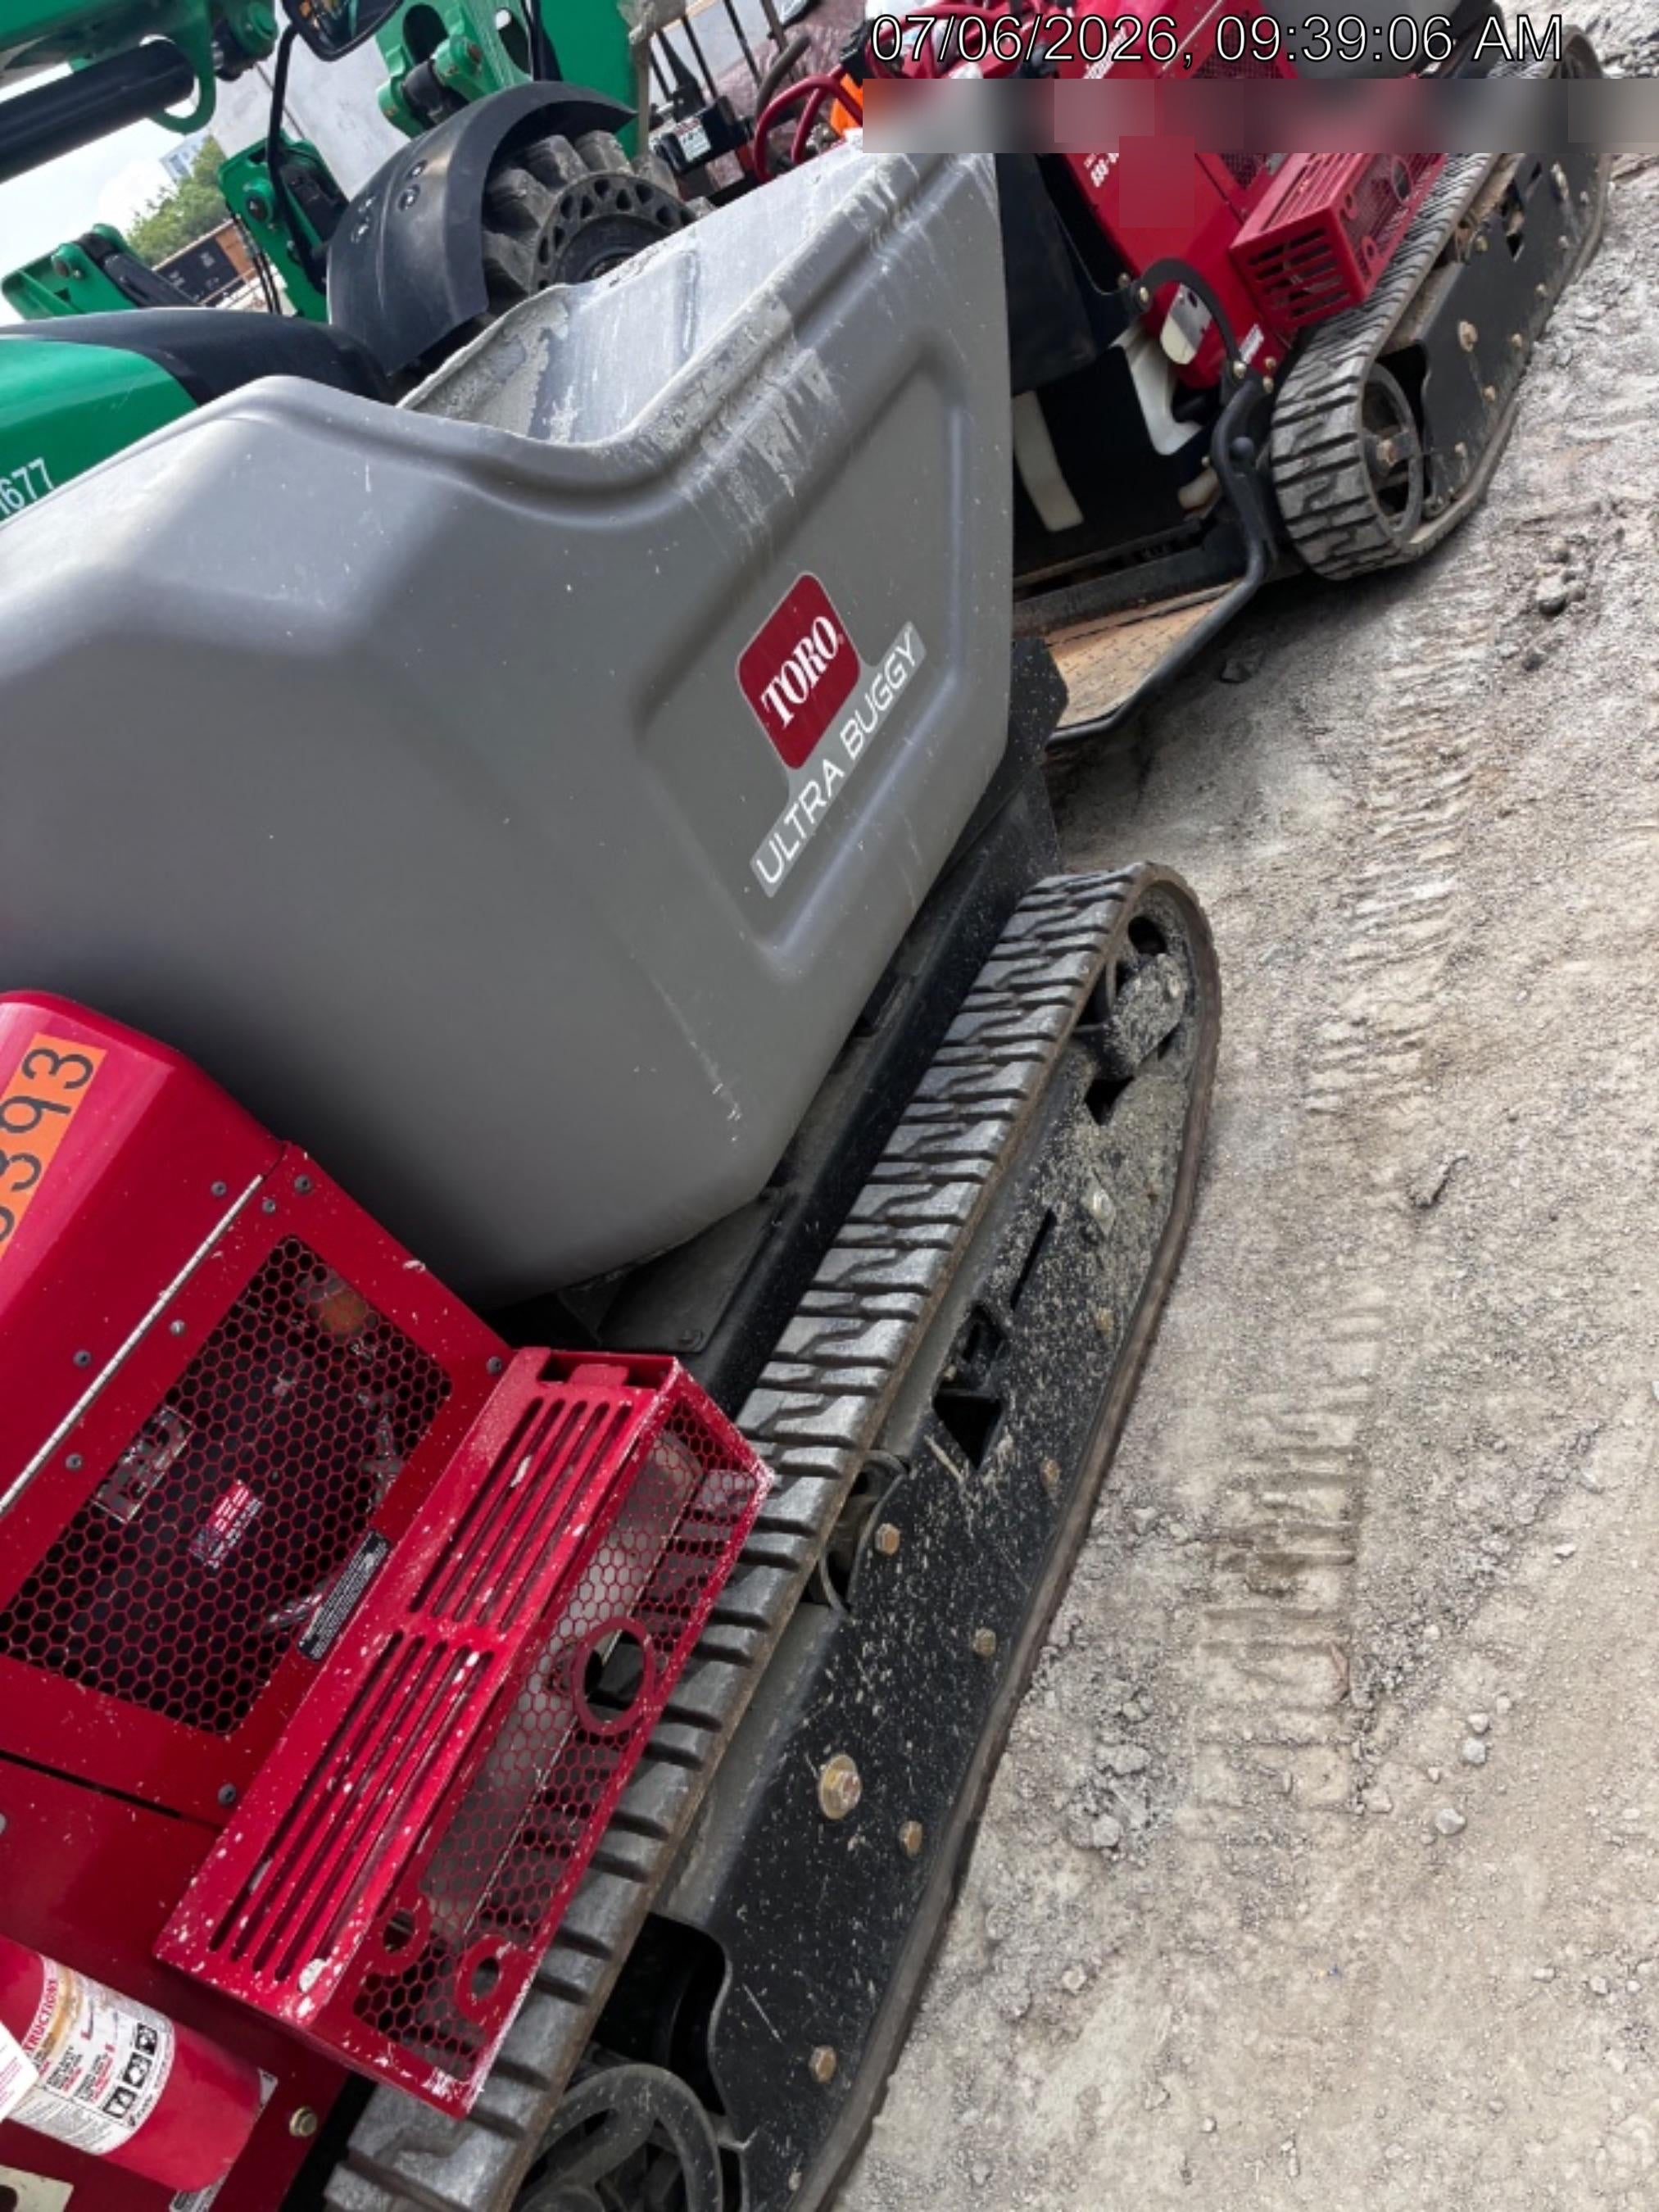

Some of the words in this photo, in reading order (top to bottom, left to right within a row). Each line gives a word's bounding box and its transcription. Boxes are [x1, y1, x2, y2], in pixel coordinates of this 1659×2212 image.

[756, 760, 845, 885] ULTRA
[840, 630, 920, 759] BUGGY
[760, 616, 839, 728] TORO
